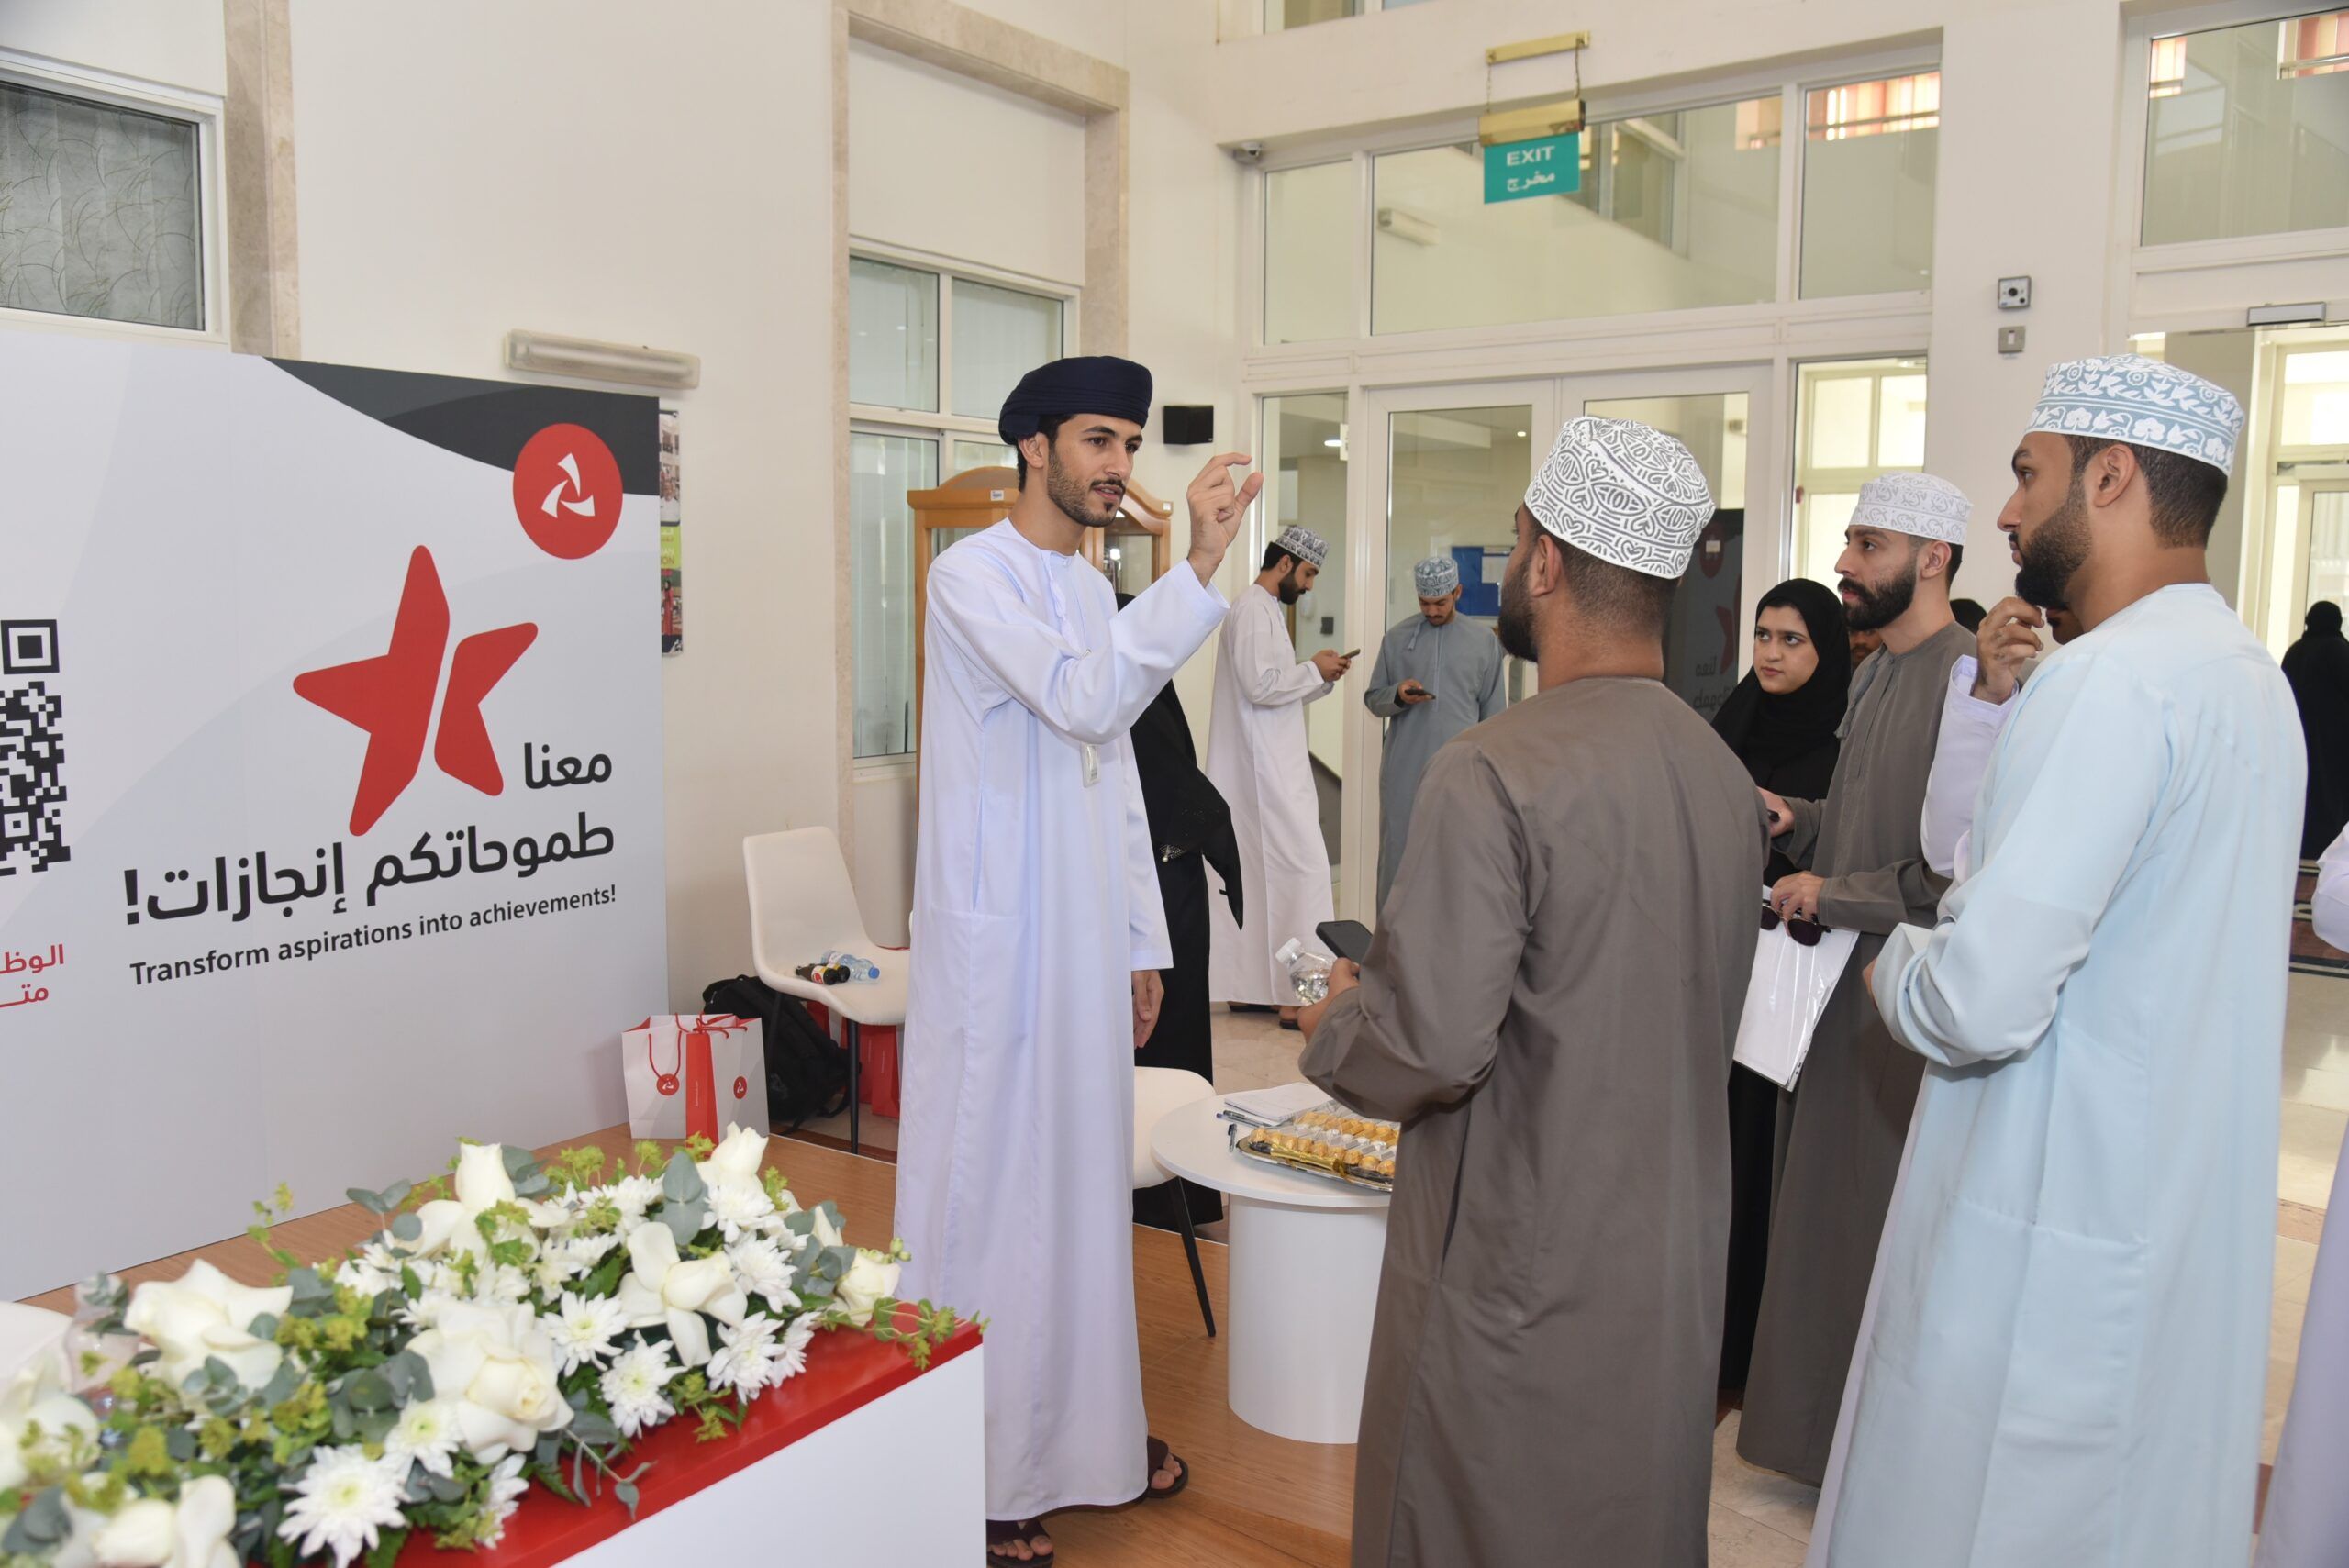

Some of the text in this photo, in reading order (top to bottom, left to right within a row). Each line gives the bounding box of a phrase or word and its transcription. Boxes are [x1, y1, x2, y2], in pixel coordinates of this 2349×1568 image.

[1506, 145, 1556, 167] EXIT
[1506, 171, 1556, 192] مخرج
[523, 741, 613, 790] معنا
[123, 810, 615, 926] طموحاتكم إنجازات!
[129, 884, 617, 986] Transform aspirations into achievements!
[0, 943, 65, 975] الوظ
